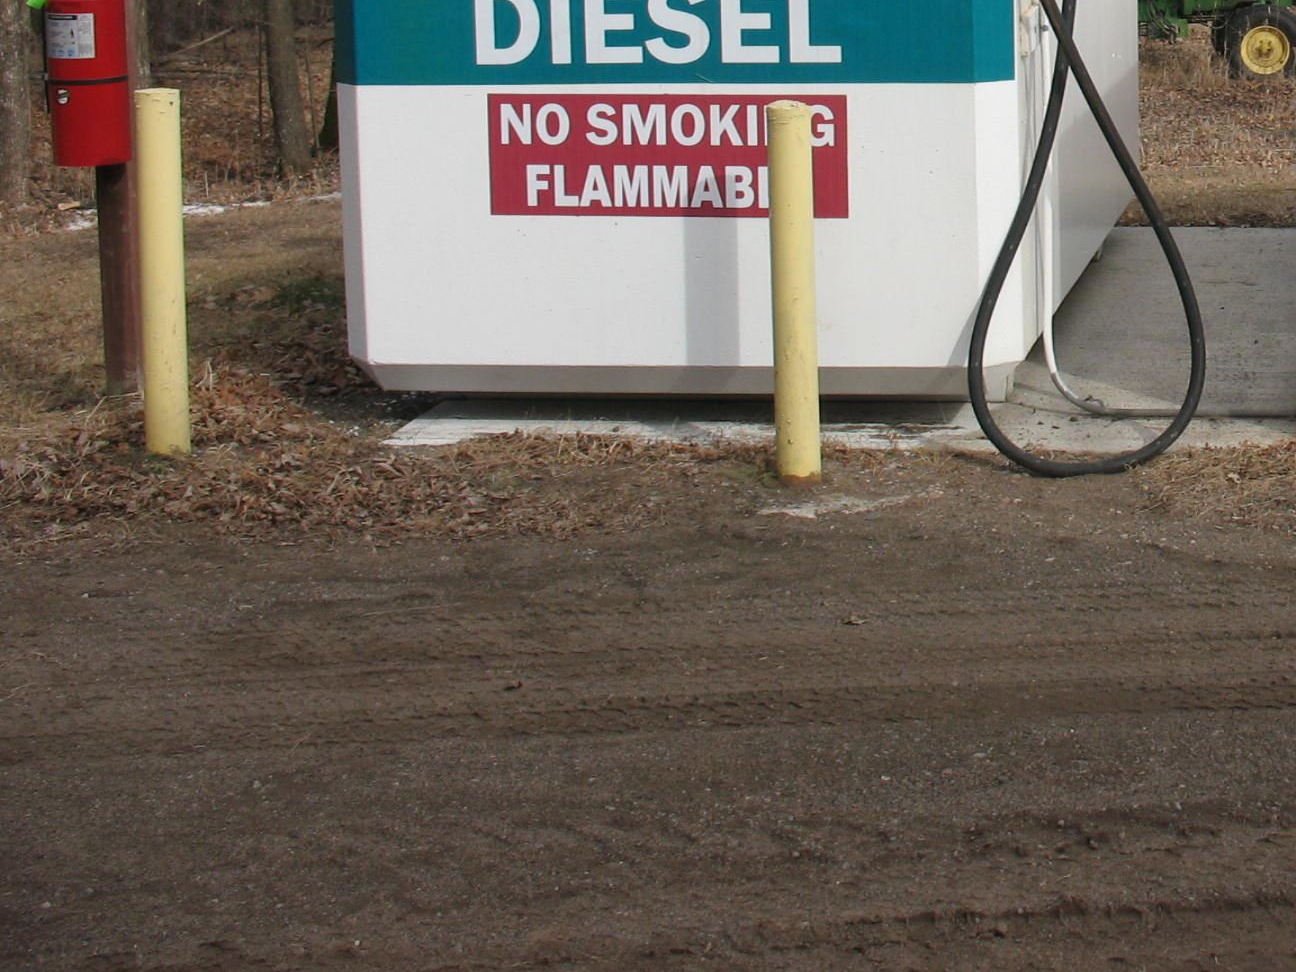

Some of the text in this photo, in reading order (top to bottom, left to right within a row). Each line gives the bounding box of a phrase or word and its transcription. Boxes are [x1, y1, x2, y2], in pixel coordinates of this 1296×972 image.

[499, 103, 835, 148] NO SMOKIG
[525, 164, 769, 210] FLAMMAB
